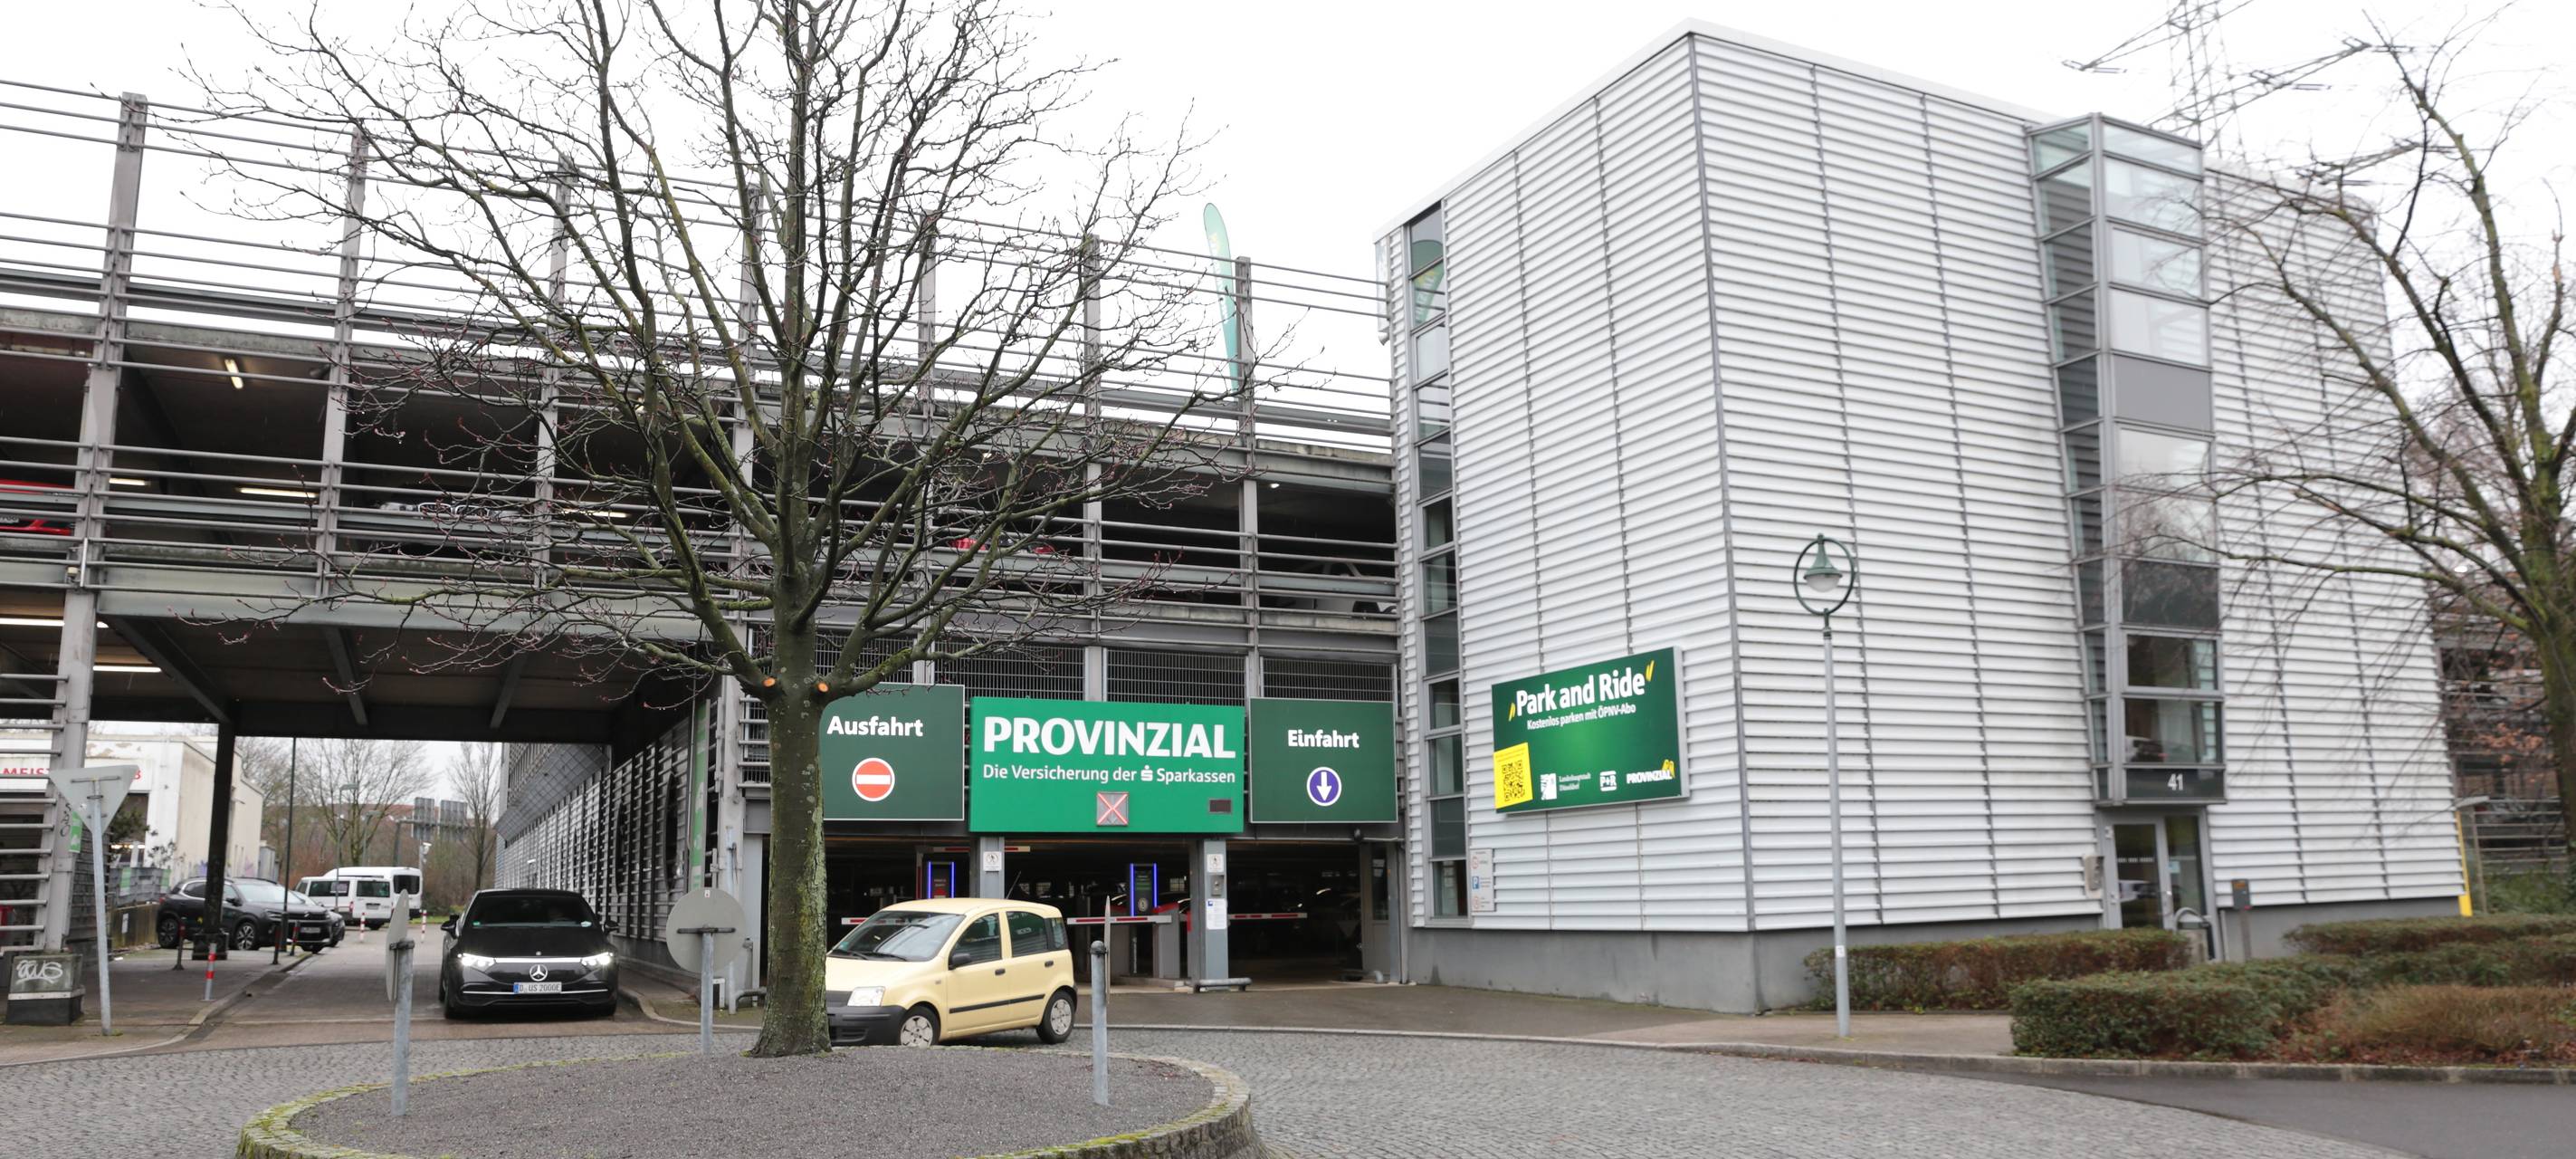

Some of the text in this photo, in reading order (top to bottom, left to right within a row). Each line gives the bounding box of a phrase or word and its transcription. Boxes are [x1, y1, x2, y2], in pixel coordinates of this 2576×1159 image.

[1516, 667, 1646, 716] Park and Ride
[826, 715, 924, 737] Ausfahrt
[1527, 703, 1636, 730] Kostenlos parken mit ÖPNV-Abo
[984, 716, 1236, 759] PROVINZIAL
[1287, 729, 1360, 749] Einfahrt
[983, 763, 1008, 779] Die
[1011, 764, 1109, 784] Versicherung
[1112, 767, 1138, 781] der
[1157, 768, 1236, 785] Sparkassen
[2167, 773, 2183, 790] 41
